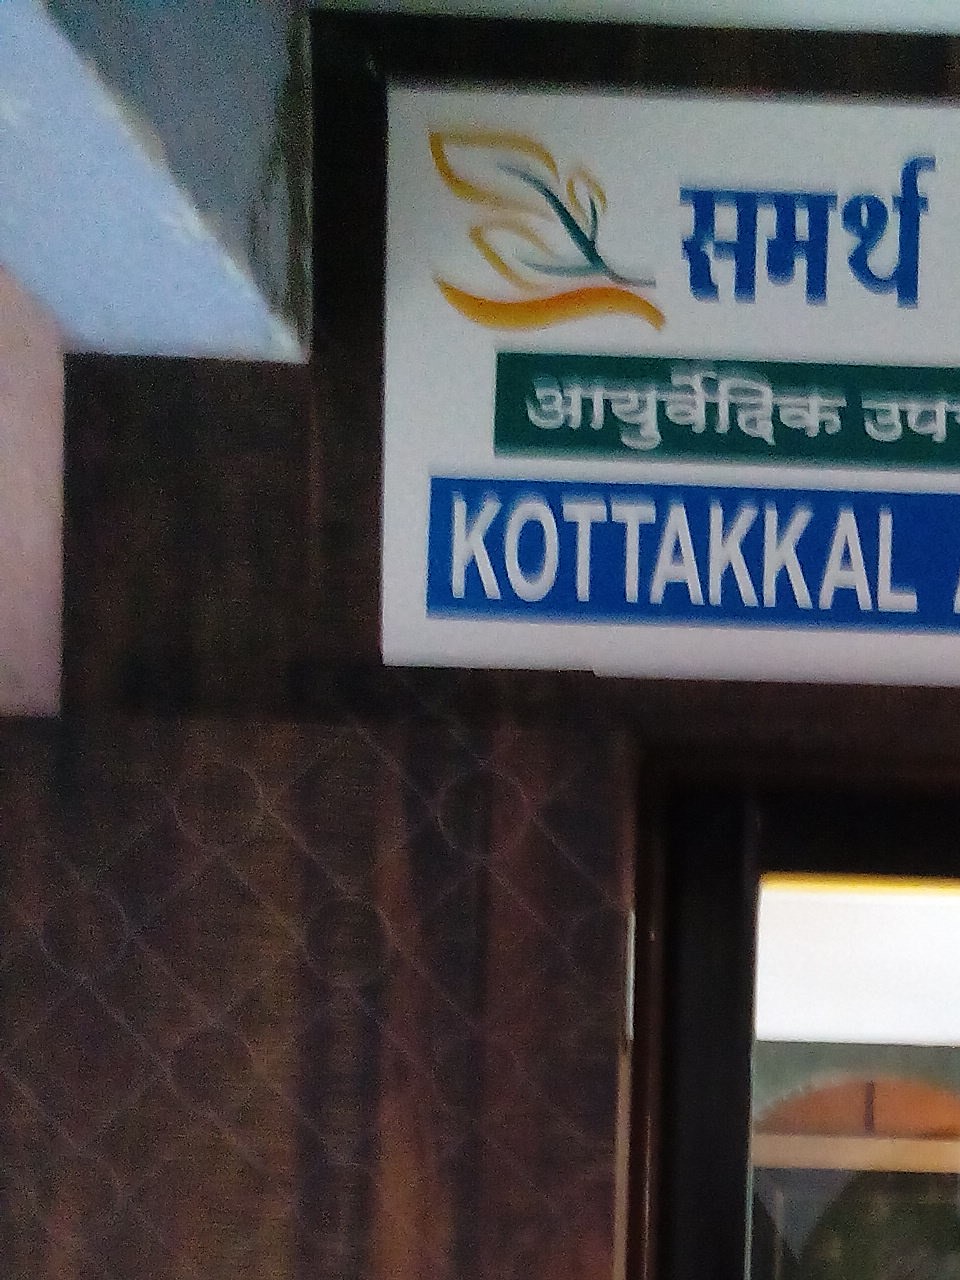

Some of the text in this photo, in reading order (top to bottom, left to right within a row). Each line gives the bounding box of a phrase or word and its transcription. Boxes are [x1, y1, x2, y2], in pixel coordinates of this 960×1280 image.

[679, 156, 937, 309] समर्थ
[526, 370, 847, 450] आयुर्वेदिक
[450, 491, 918, 612] KOTTAKKAL
